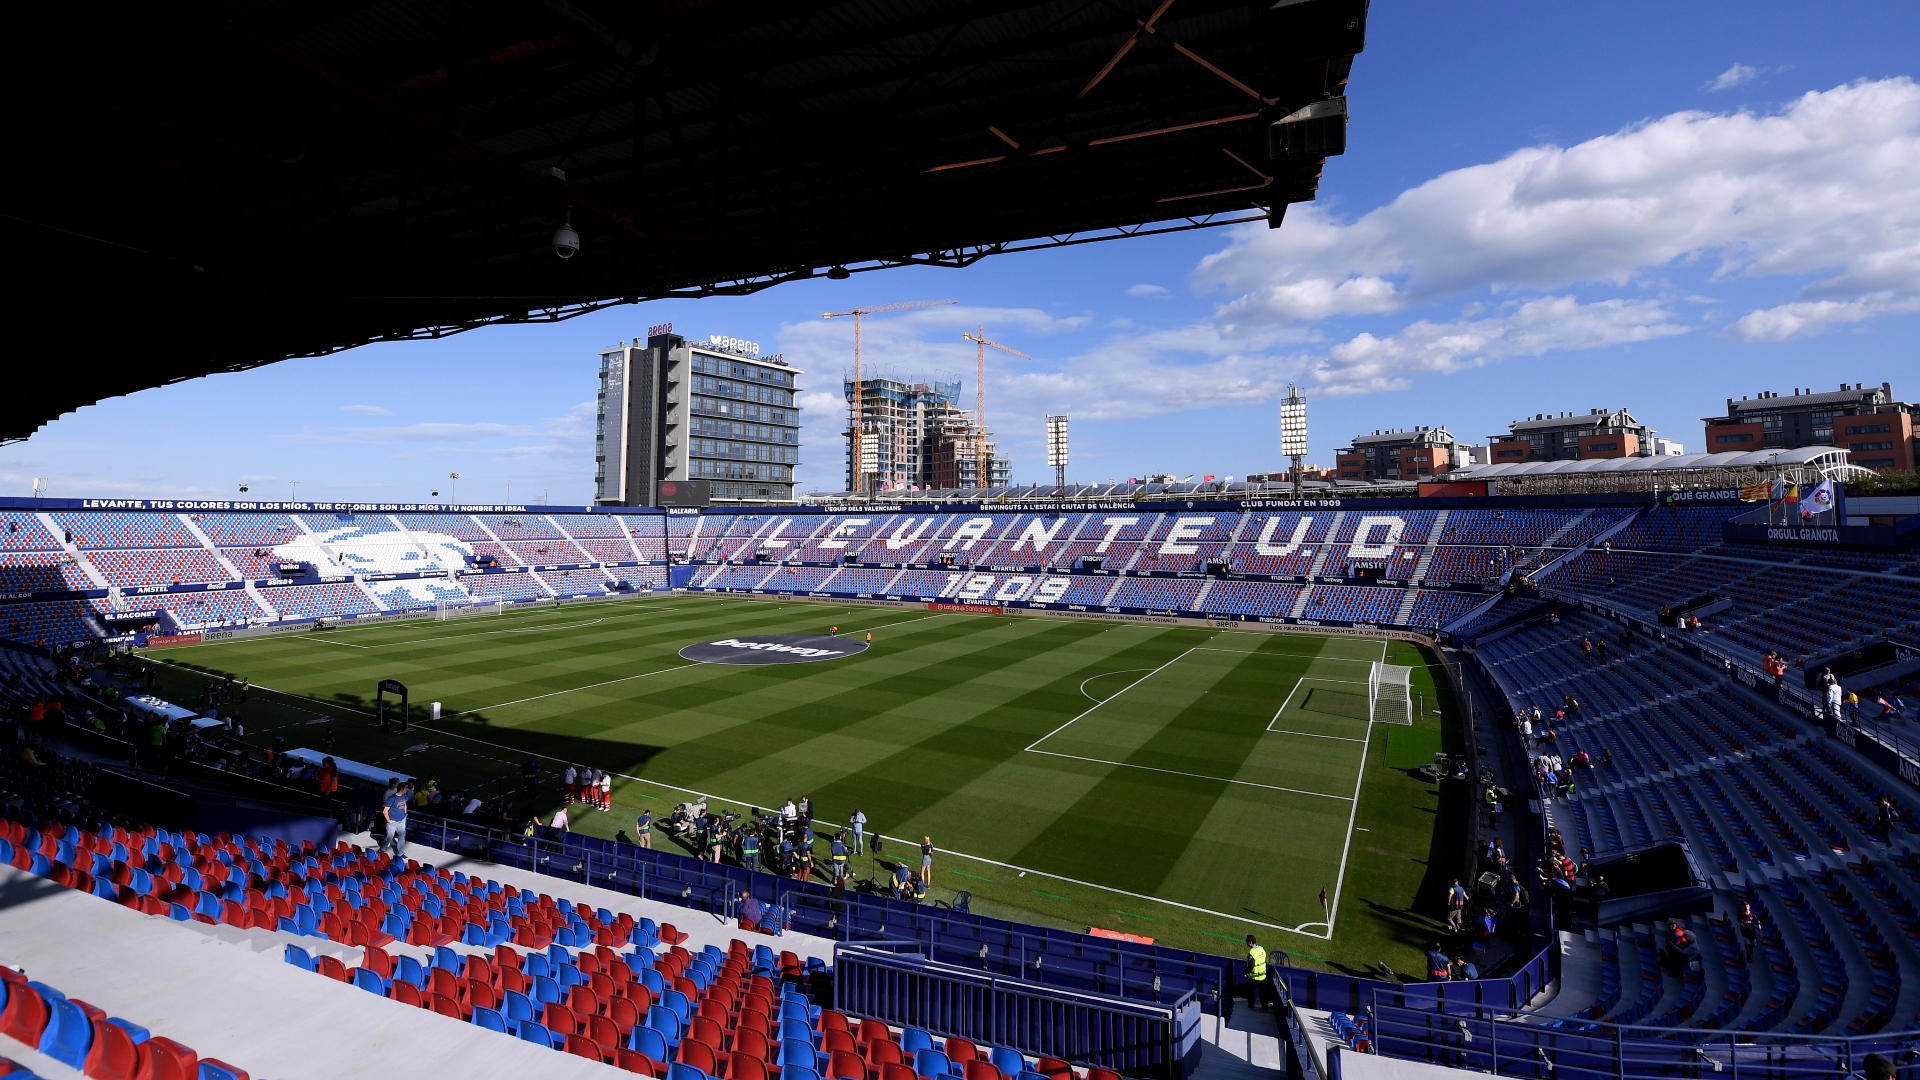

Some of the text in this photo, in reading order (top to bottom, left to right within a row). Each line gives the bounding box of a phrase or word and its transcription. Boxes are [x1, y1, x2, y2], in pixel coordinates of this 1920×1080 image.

[723, 336, 760, 354] arena
[1672, 490, 1694, 501] QUÉ
[1696, 490, 1736, 500] GRANDE
[83, 500, 146, 510] LEVANTE,
[150, 500, 173, 509] TUS
[176, 501, 230, 510] COLORES
[234, 502, 256, 510] SON
[260, 502, 280, 510] LOS
[282, 501, 310, 510] MÍOS,
[418, 503, 439, 512] MÍOS
[1100, 502, 1136, 510] VALÈNCIA
[760, 517, 1216, 554] LEVANTE
[1768, 528, 1838, 542] ORGULL GRANOTA
[137, 586, 169, 594] AMSTEL
[939, 573, 1072, 603] 1909
[117, 610, 156, 619] RACONET
[204, 631, 232, 641] arena
